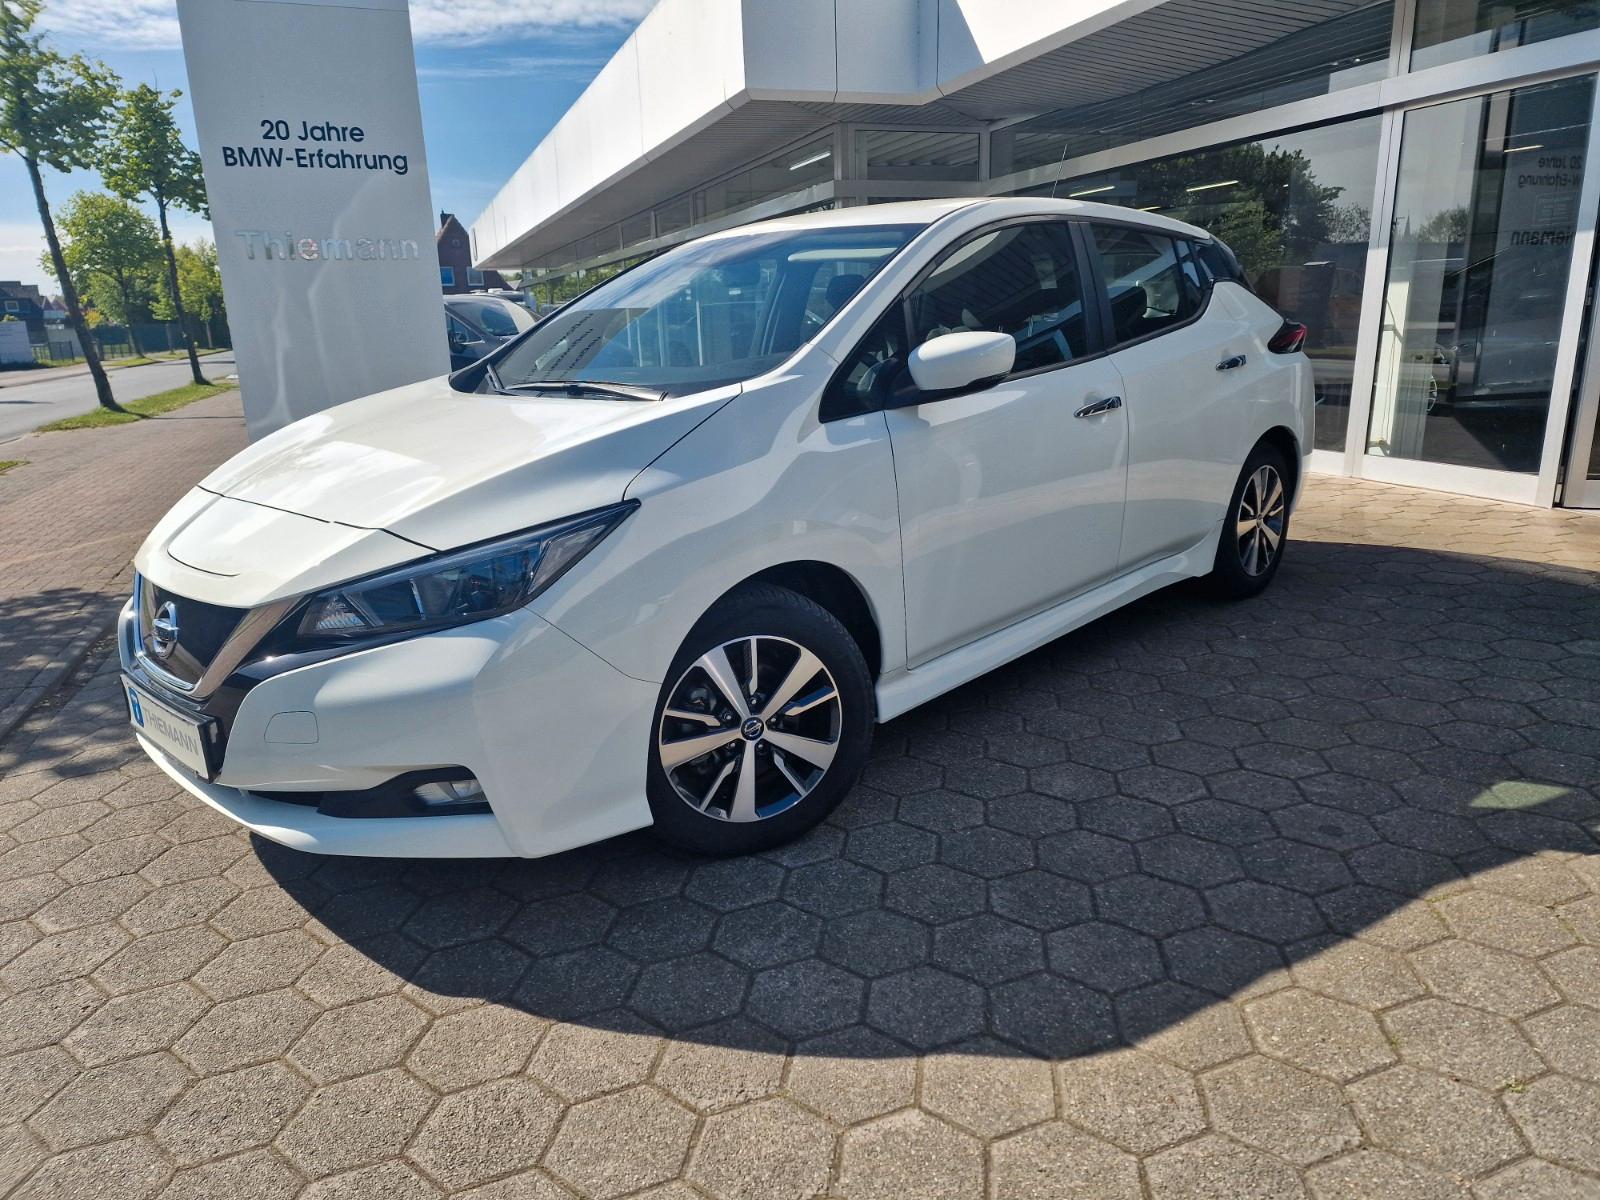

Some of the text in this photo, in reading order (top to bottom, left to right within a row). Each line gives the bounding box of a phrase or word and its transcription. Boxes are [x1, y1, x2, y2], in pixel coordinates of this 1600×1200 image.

[260, 119, 365, 142] 20 Jahre
[222, 146, 409, 175] BMW-Erfahrung
[236, 230, 418, 261] Thiemann
[144, 707, 199, 755] THIEMANN
